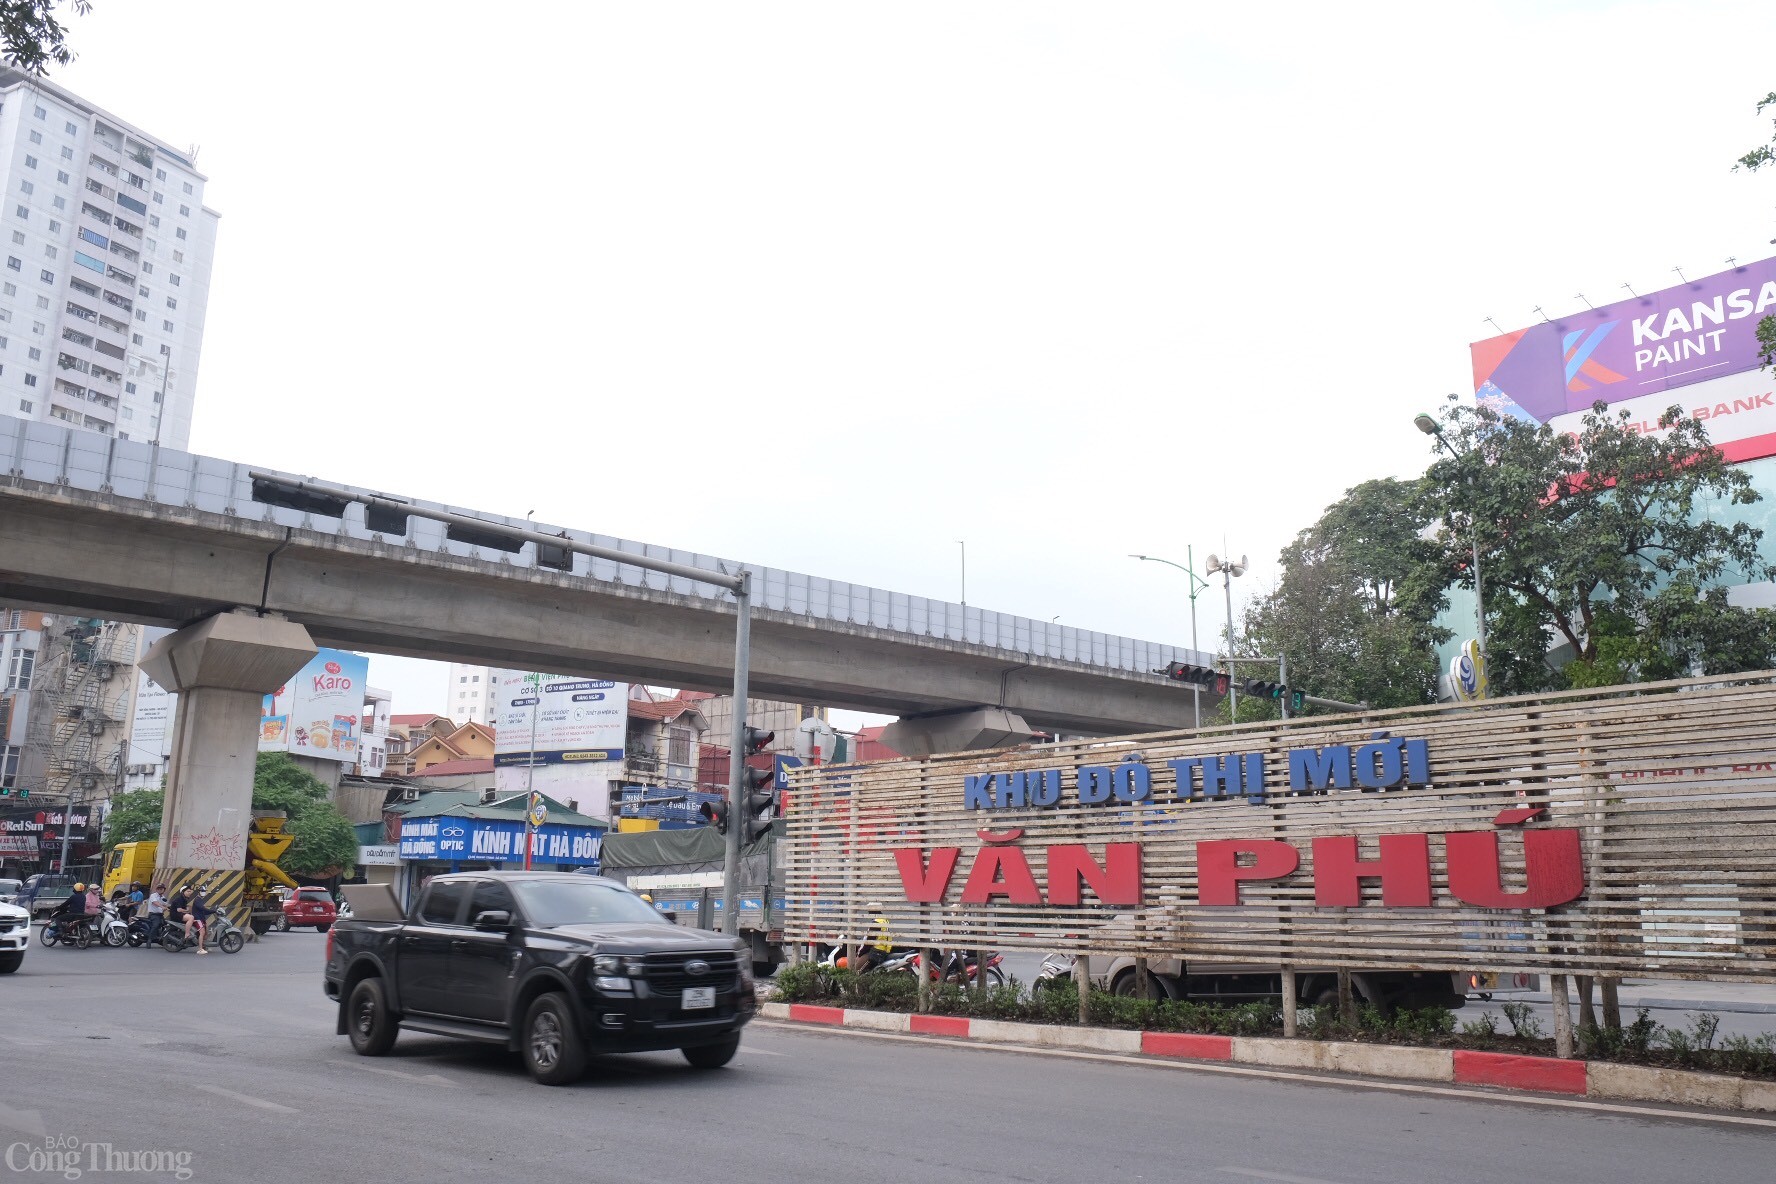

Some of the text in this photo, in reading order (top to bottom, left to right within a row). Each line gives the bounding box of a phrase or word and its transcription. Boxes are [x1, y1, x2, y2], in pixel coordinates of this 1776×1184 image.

[1632, 281, 1776, 346] KANSA
[1635, 329, 1726, 371] PAINT
[1692, 392, 1775, 421] BANK
[313, 674, 351, 691] Karo
[964, 731, 1430, 810] KHU ĐÔ THỊ MỚI
[6, 820, 43, 831] Red Sun
[401, 818, 439, 837] KÍNH MẮT
[401, 838, 412, 854] HÀ
[413, 838, 436, 854] ĐÔNG
[440, 840, 464, 851] OPTIC
[472, 825, 510, 855] KÍNH
[549, 830, 571, 858] HÀ
[892, 807, 1585, 909] VĂN PHÚ
